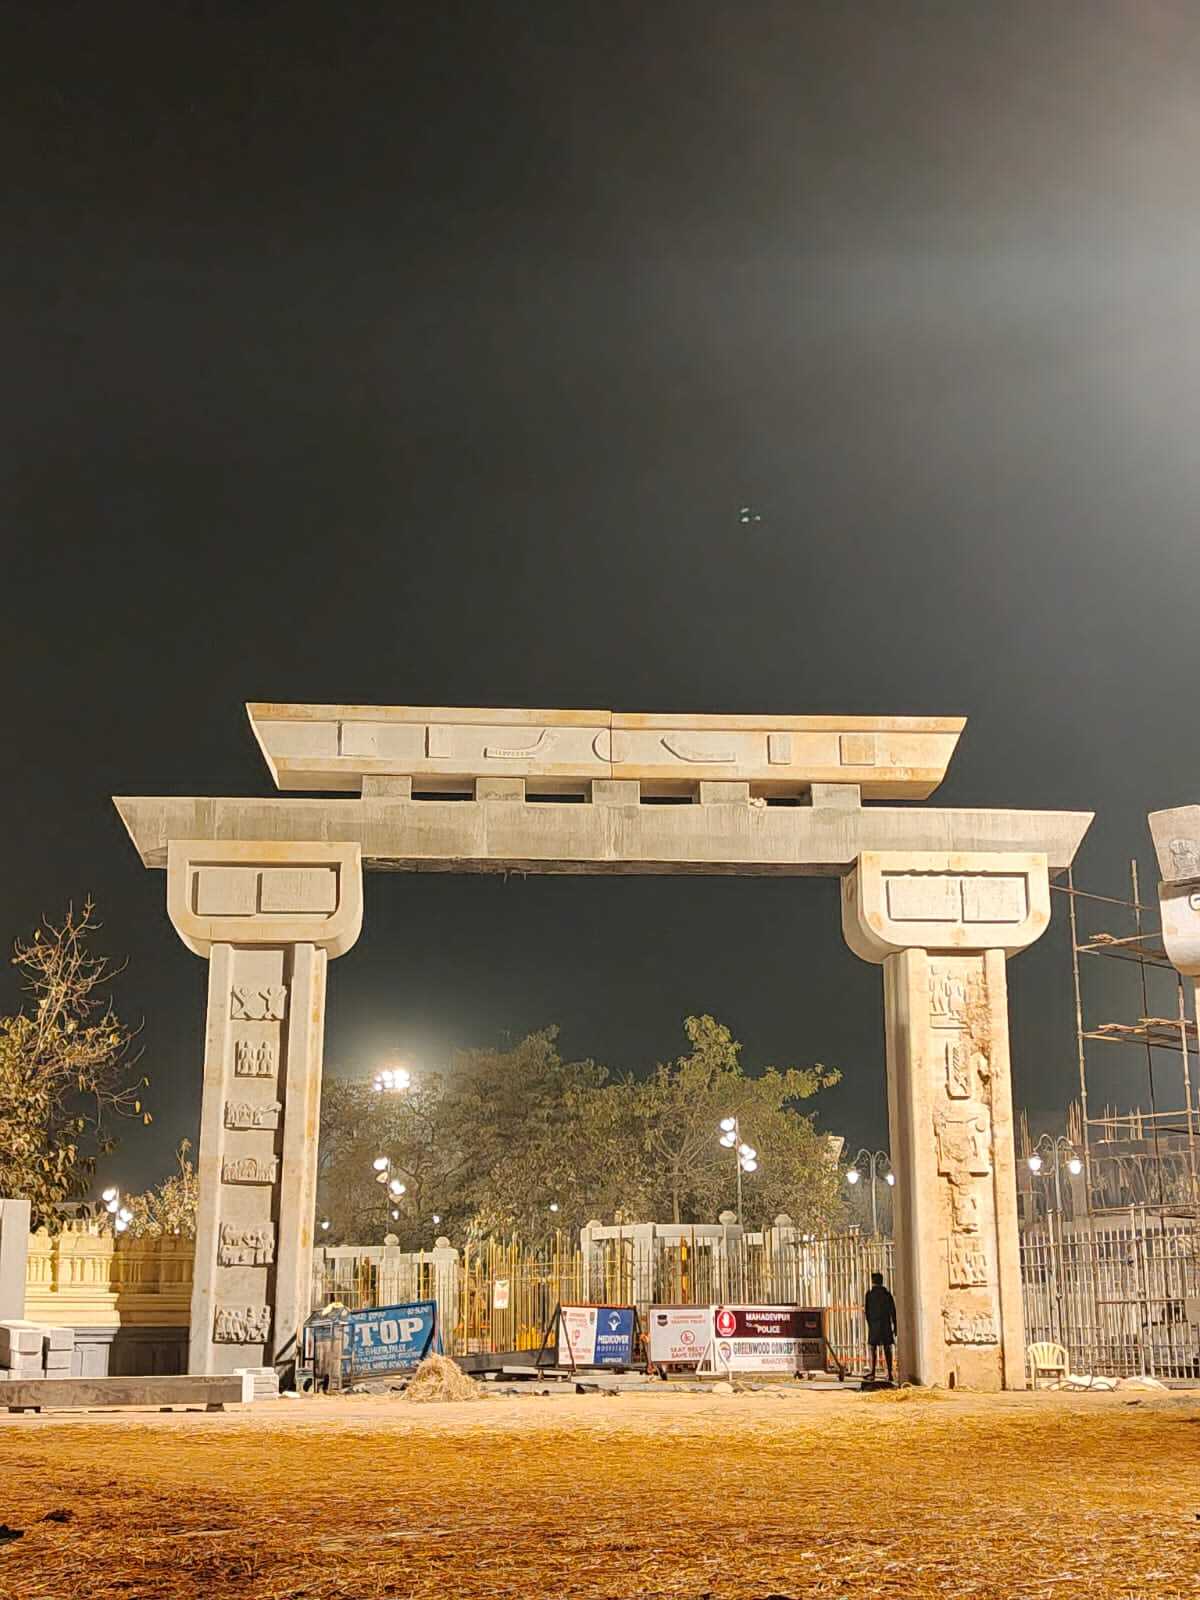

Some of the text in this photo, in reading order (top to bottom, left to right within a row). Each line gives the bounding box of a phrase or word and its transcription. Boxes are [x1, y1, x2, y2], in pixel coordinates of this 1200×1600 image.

[745, 1312, 790, 1321] MAHADEVPUR
[757, 1325, 781, 1334] POLICE
[733, 1341, 821, 1355] GREENWOOD CONCEPT SCHOOL
